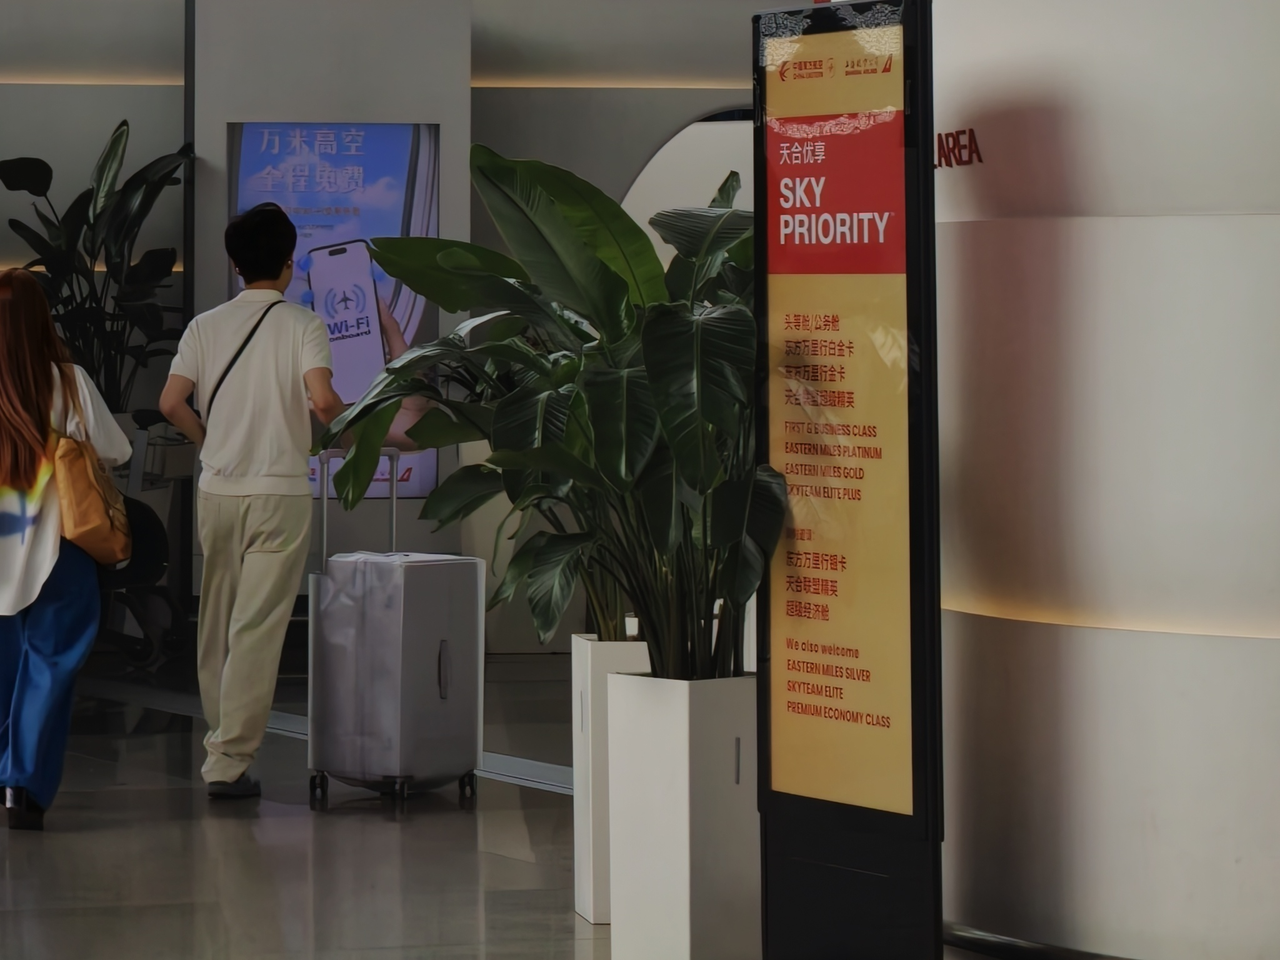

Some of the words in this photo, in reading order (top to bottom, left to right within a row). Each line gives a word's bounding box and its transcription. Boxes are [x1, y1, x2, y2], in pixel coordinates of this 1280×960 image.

[259, 128, 366, 156] 万米高空
[937, 128, 984, 169] AREA
[779, 141, 826, 166] 天合优享
[779, 176, 826, 209] SKY
[780, 212, 889, 244] PRIORITY
[327, 316, 370, 335] Wi-Fi
[784, 339, 855, 358] 东方万里行白金卡
[784, 421, 805, 435] FIRST
[807, 422, 813, 434] &
[814, 423, 851, 436] BUSINESS
[852, 424, 877, 437] CLASS
[785, 442, 818, 456] EASTERN
[819, 443, 841, 457] MILES
[843, 446, 882, 459] PLATINUM
[785, 463, 818, 476] EASTERN
[820, 464, 841, 478] MILES
[843, 467, 865, 480] GOLD
[823, 486, 841, 499] ELITE
[843, 488, 862, 501] PLUS
[786, 637, 799, 650] We
[801, 639, 819, 654] also
[821, 643, 859, 659] welcome
[787, 659, 821, 675] EASTERN
[822, 663, 843, 679] MILES
[845, 667, 871, 682] SILVER
[787, 680, 823, 696] SKYTEAM
[825, 685, 843, 700] ELITE
[787, 700, 822, 718] PREMIUM
[824, 706, 864, 724] ECONOMY
[865, 713, 891, 729] CLASS
